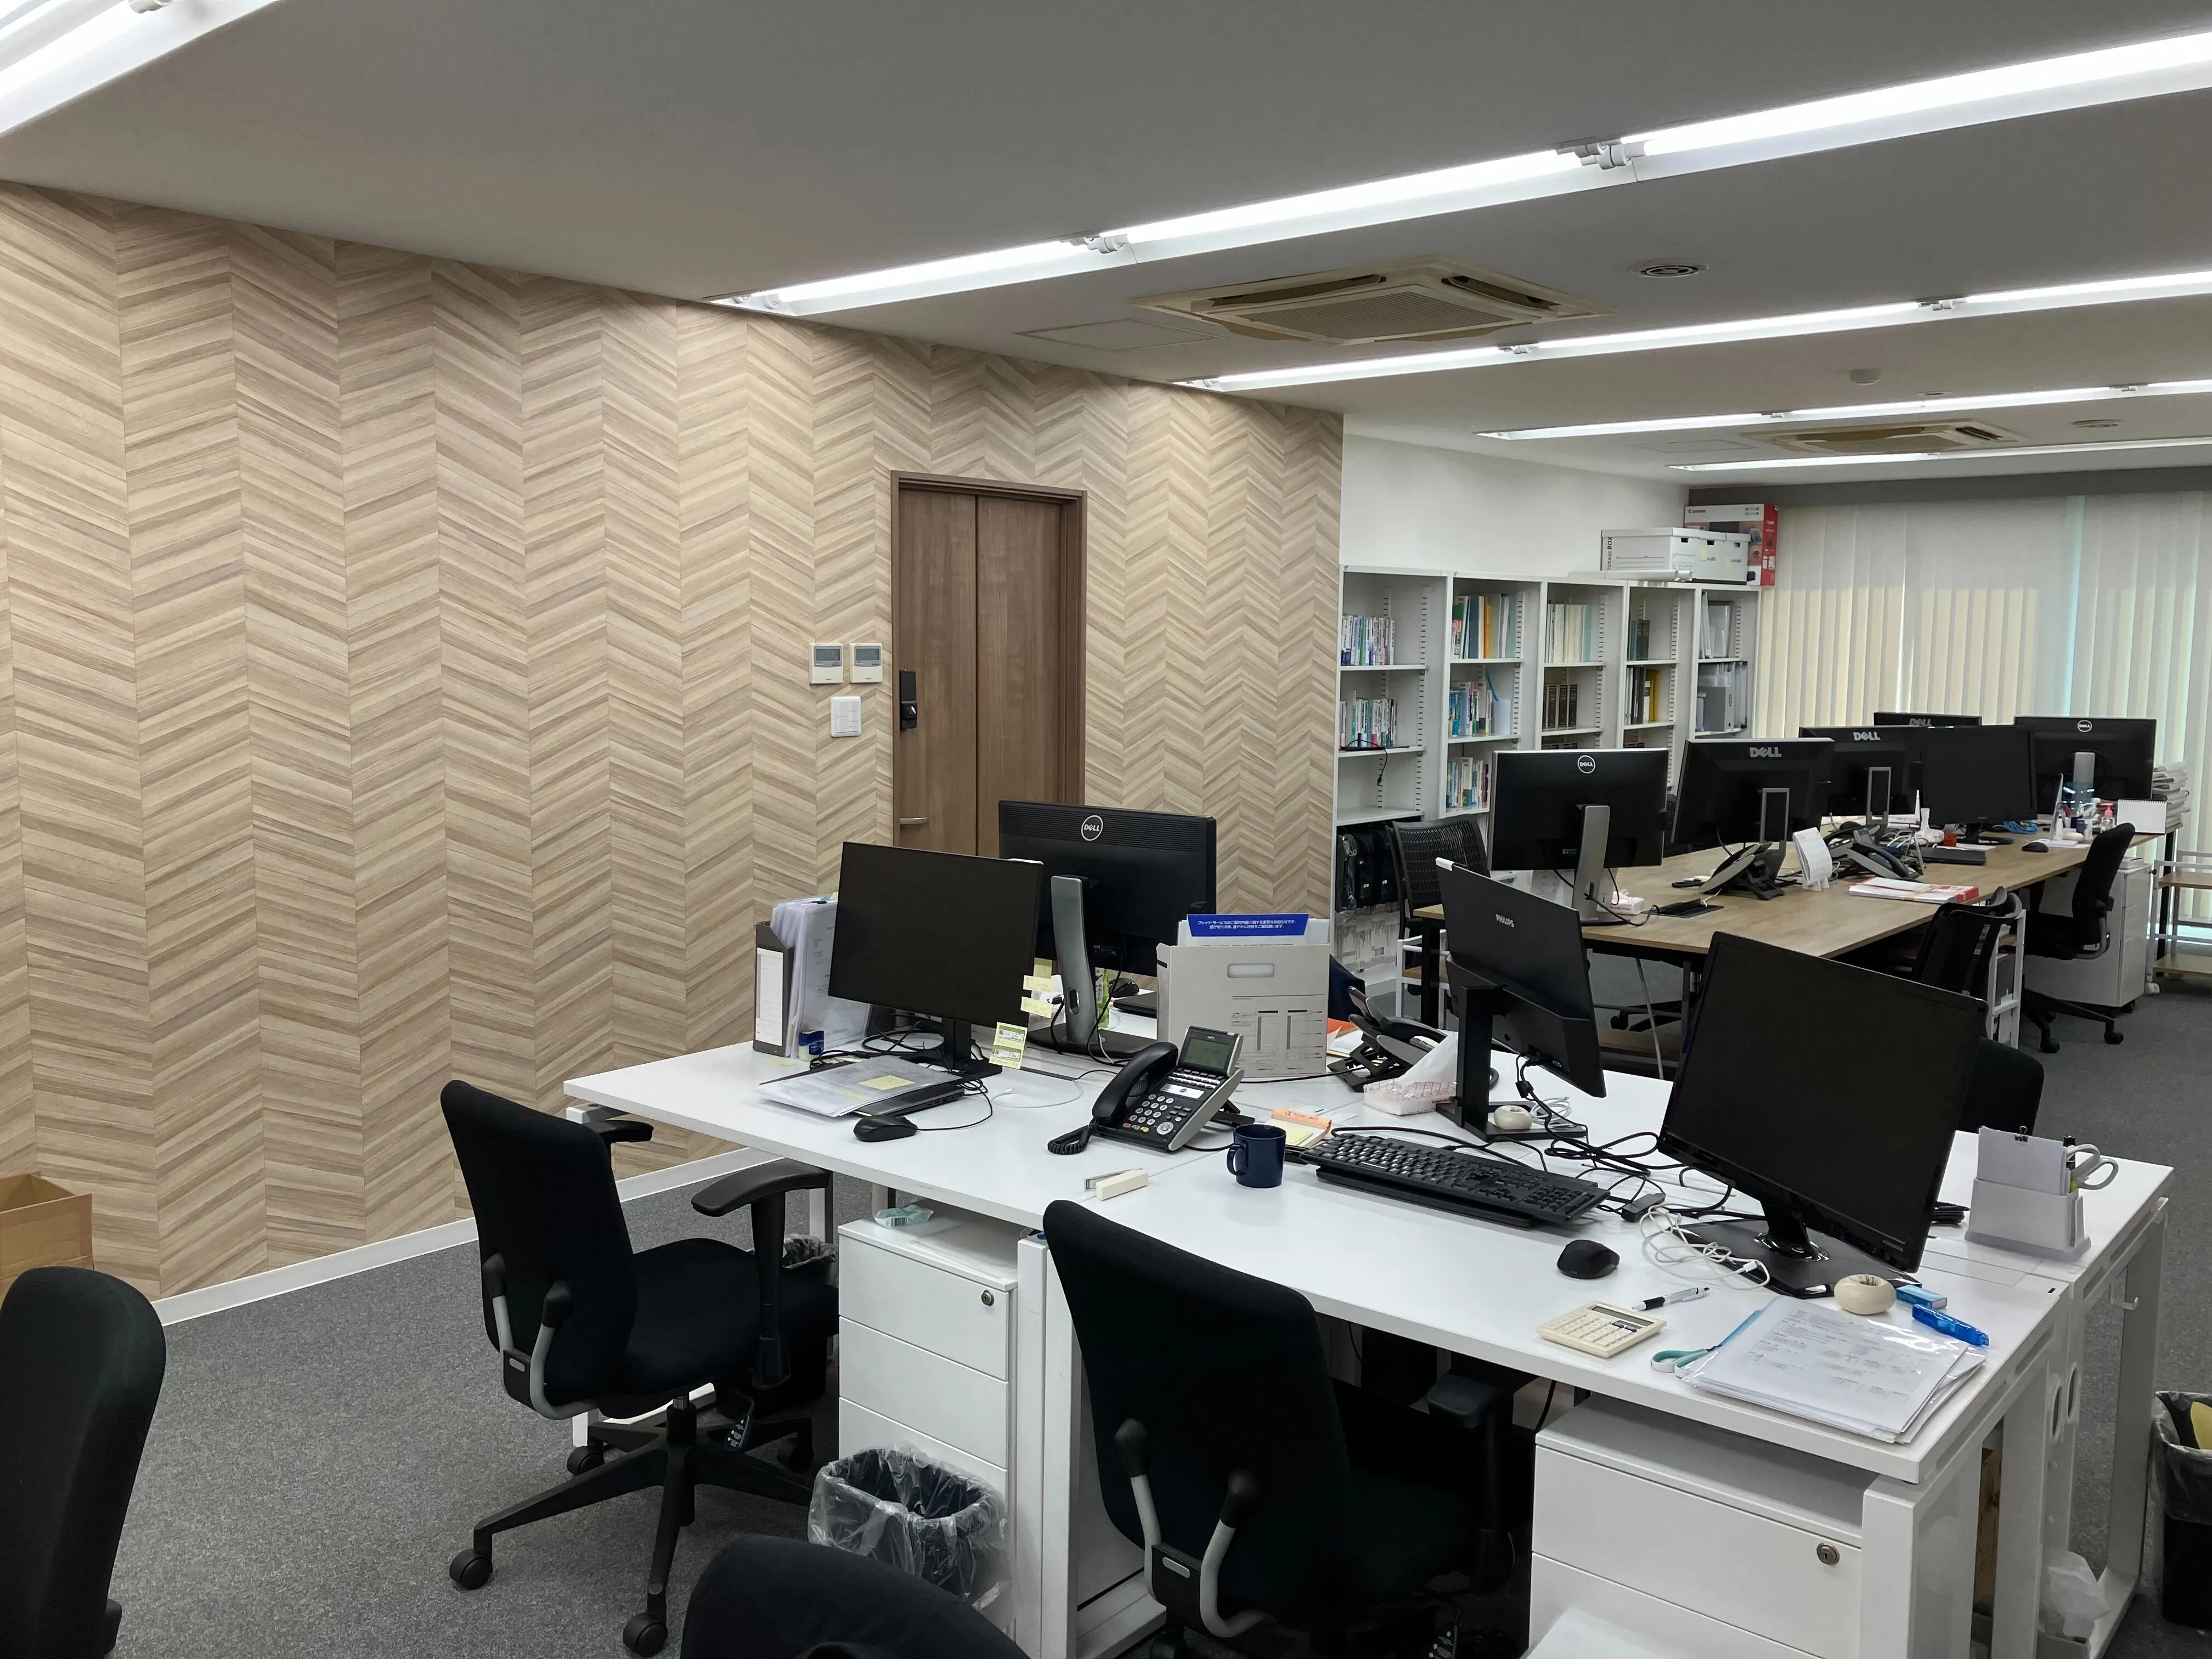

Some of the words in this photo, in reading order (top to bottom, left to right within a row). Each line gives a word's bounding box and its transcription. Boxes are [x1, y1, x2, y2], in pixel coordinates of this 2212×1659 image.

[1909, 718, 1932, 726] DELL
[1853, 731, 1881, 741] DELL
[1750, 747, 1782, 758] DELL
[1496, 913, 1514, 927] PHILIPS
